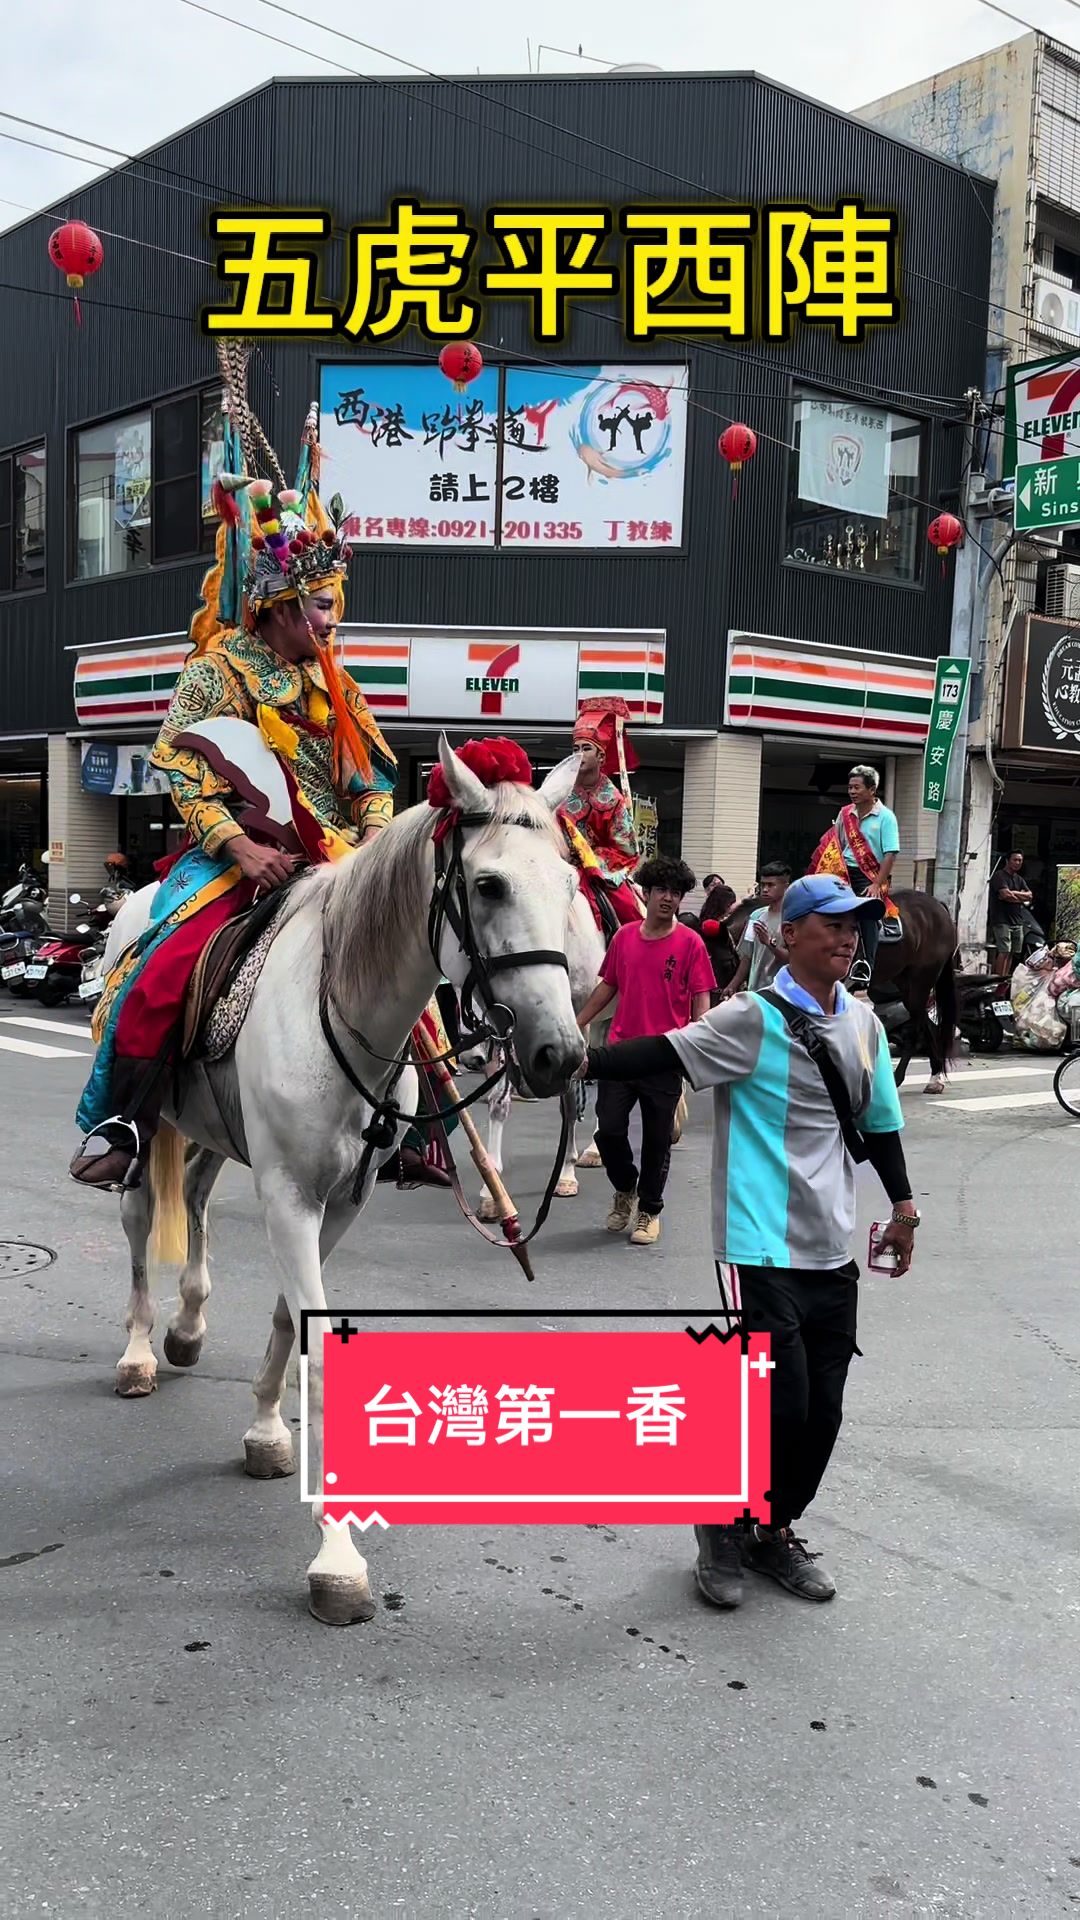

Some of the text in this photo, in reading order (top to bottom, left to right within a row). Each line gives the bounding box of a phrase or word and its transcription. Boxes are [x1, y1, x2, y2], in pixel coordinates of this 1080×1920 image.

[429, 472, 560, 503] 請上2樓
[1034, 466, 1080, 497] 新
[603, 520, 673, 541] 丁教練
[468, 643, 520, 714] 7
[942, 684, 959, 698] 173
[928, 710, 954, 802] 慶安路
